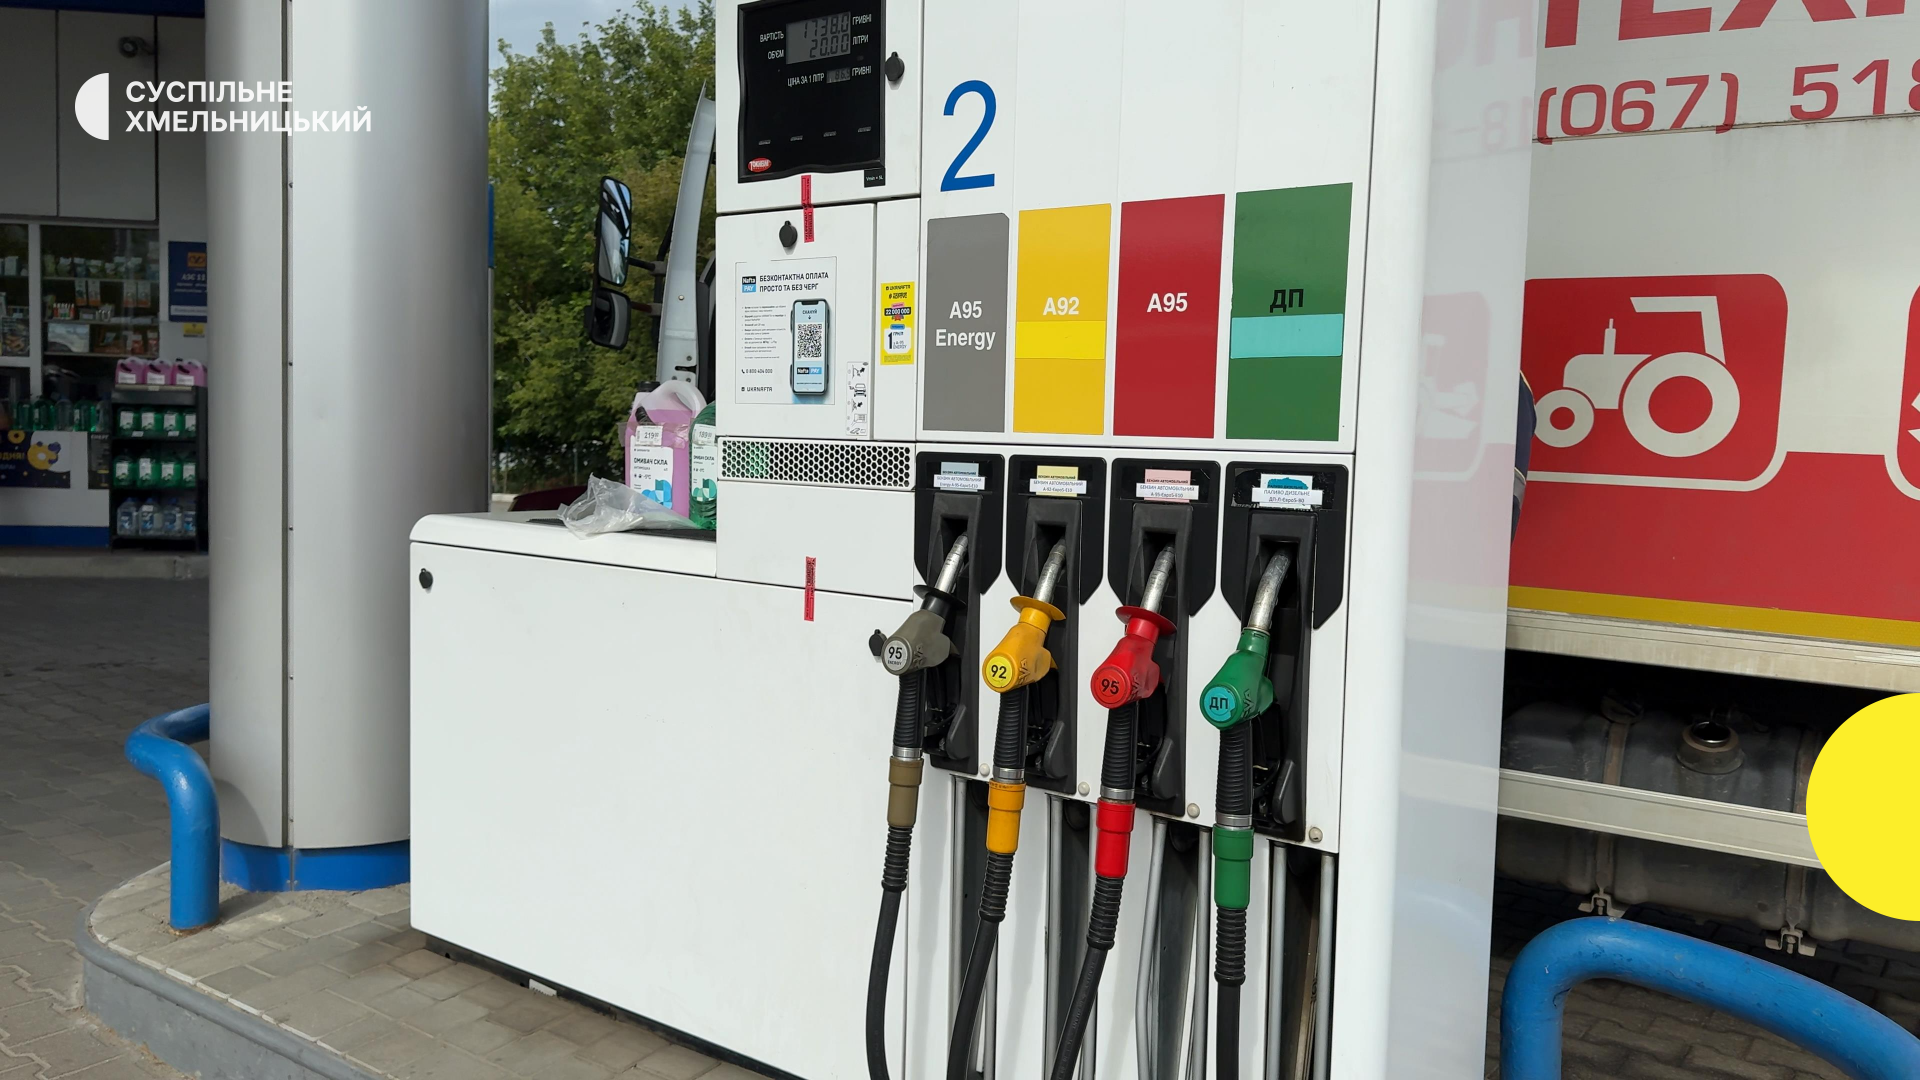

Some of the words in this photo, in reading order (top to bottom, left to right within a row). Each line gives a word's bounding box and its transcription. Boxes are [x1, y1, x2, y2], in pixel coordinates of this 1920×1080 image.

[760, 31, 785, 43] ВАРТІСТЬ
[852, 14, 872, 25] ГРИВНІ
[768, 50, 785, 59] ОБ'ЄМ
[852, 34, 869, 45] ЛІТРИ
[788, 76, 800, 87] ЦІНА
[801, 76, 808, 84] ЗА
[813, 73, 824, 82] ЛІТР
[852, 66, 872, 76] ГРИВНІ
[1537, 73, 1739, 145] (067)
[1790, 59, 1920, 120] 51
[940, 80, 997, 192] 2
[760, 273, 804, 282] БЕЗКОНТАКТНА
[806, 272, 829, 280] ОПЛАТА
[760, 284, 782, 292] ПРОСТО
[949, 301, 982, 320] A95
[1043, 297, 1080, 316] A92
[1146, 292, 1188, 313] A95
[1270, 289, 1304, 314] ДП
[935, 329, 996, 351] Energy
[889, 646, 903, 660] 95
[991, 665, 1007, 680] 92
[1101, 678, 1120, 695] 95
[1209, 697, 1229, 710] ДП
